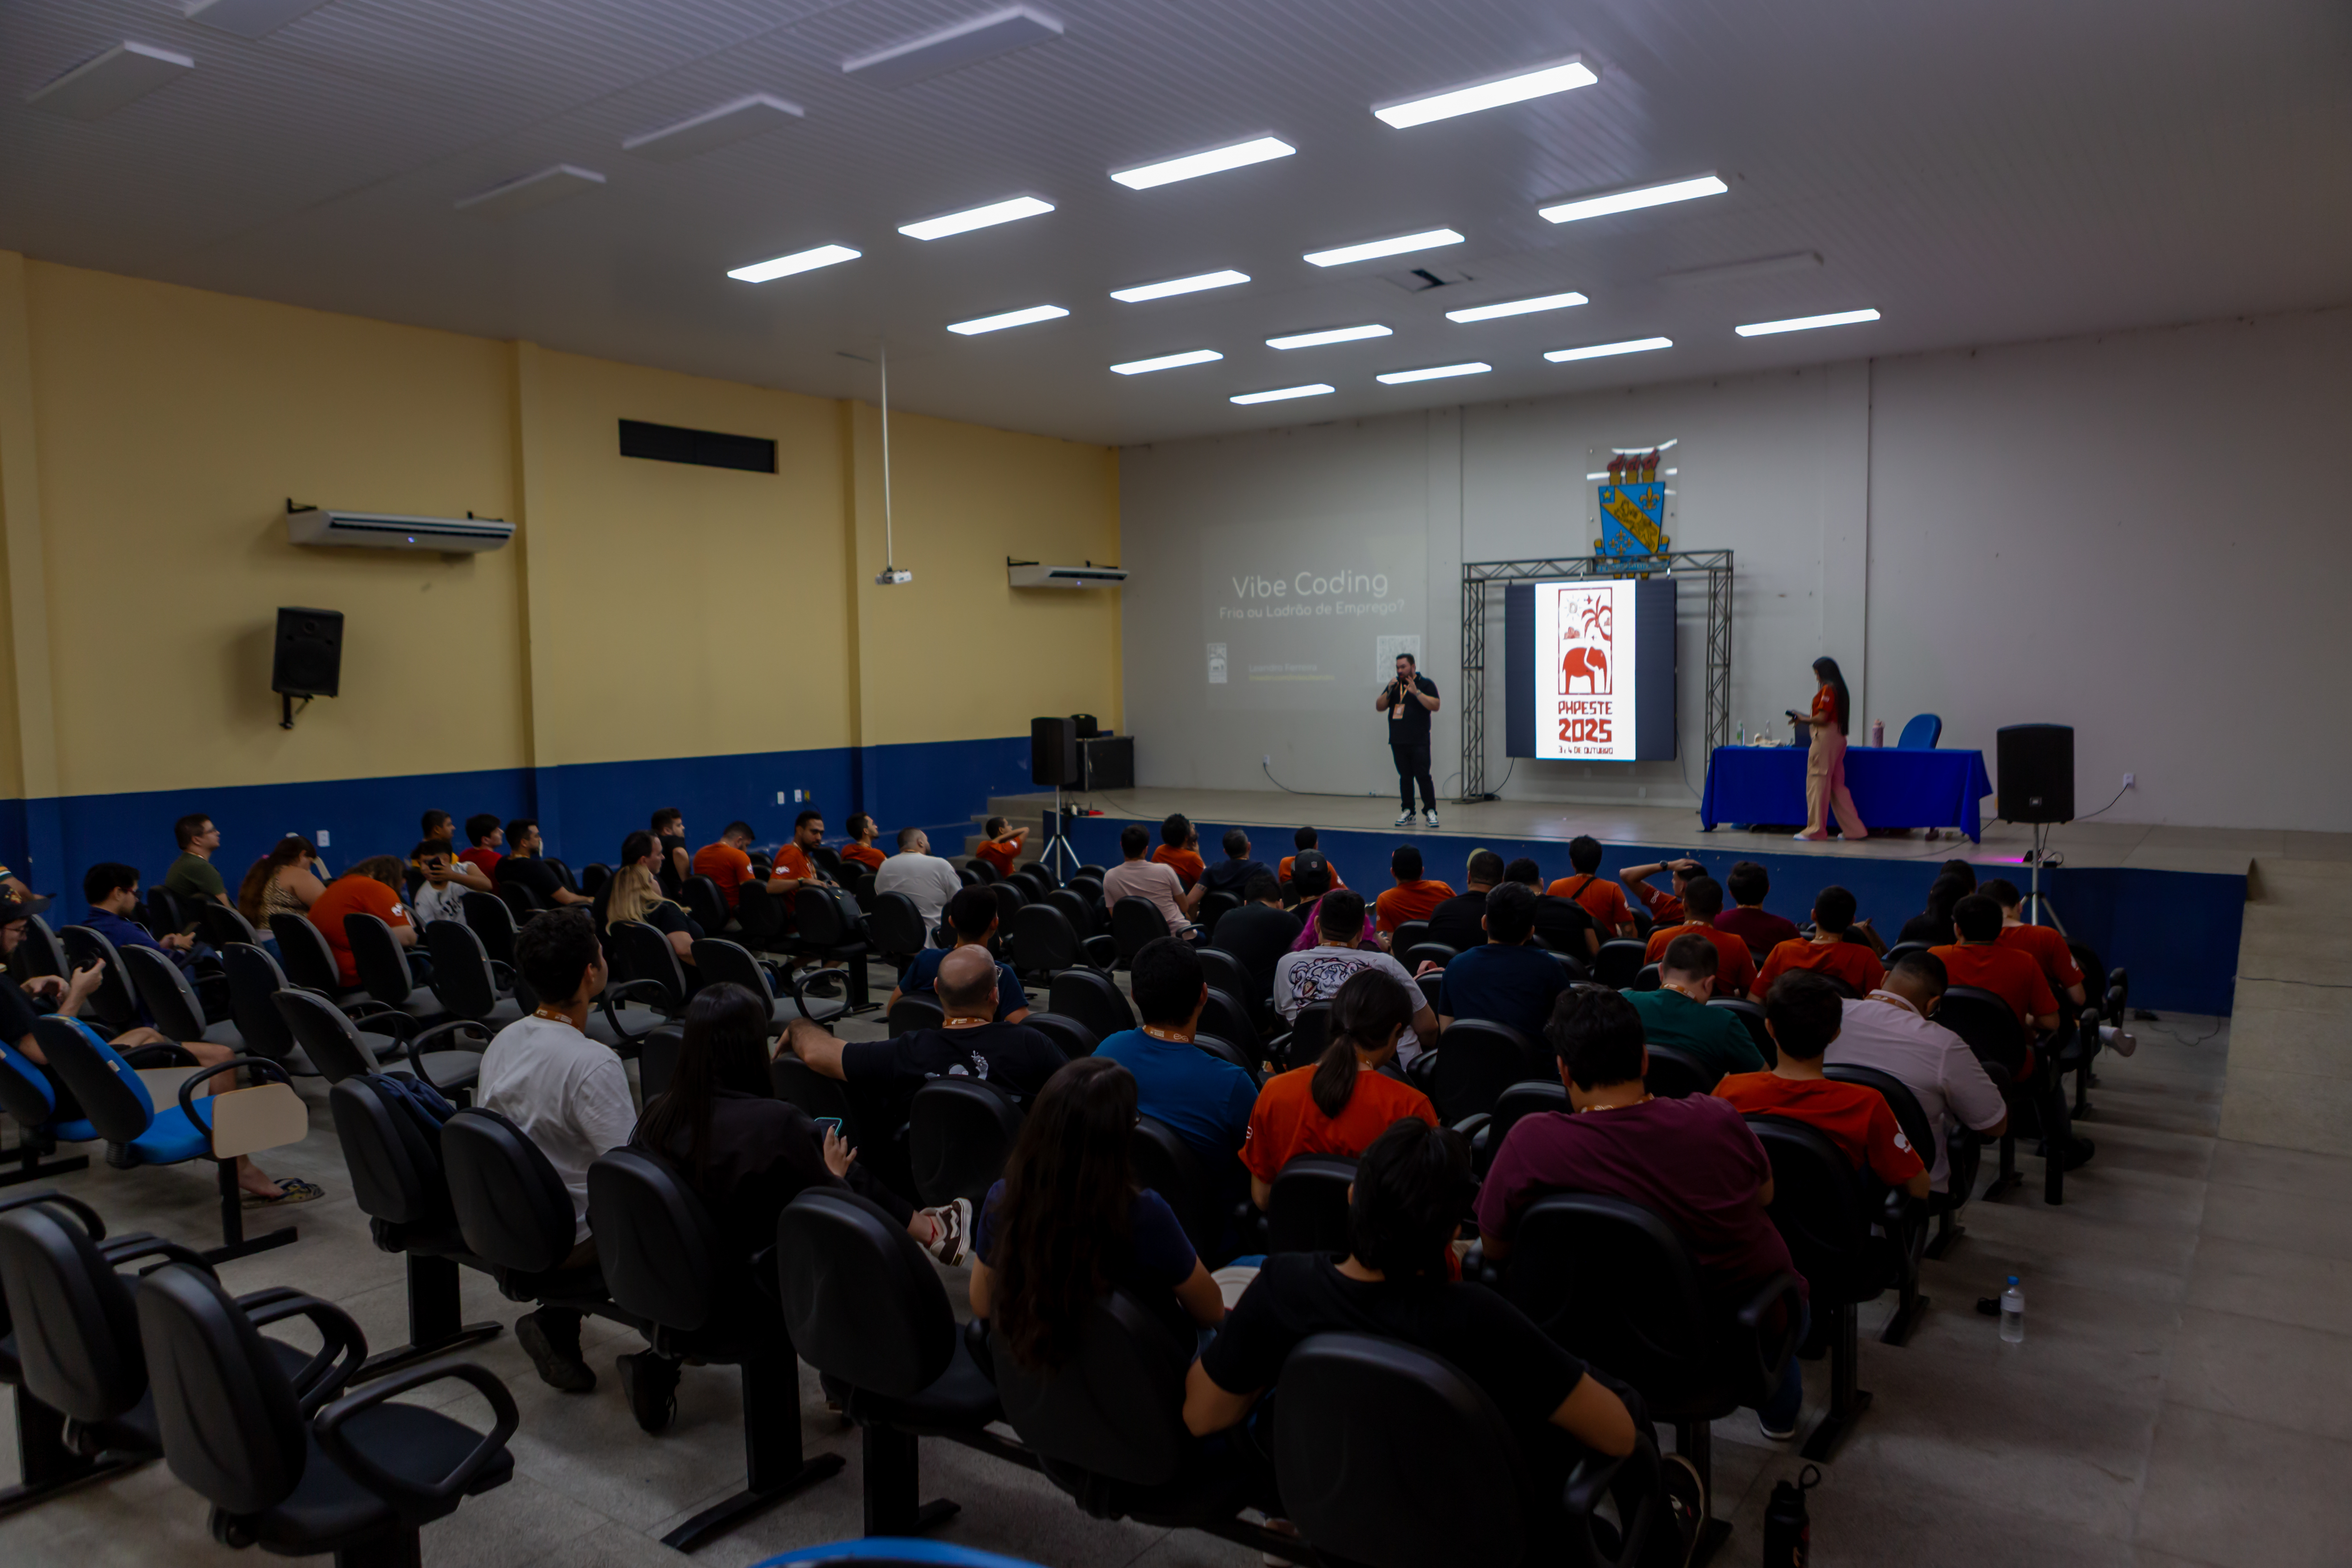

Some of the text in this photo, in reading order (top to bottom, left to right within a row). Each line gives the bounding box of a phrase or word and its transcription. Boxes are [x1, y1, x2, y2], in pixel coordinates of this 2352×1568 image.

[1232, 570, 1388, 598] Vibe Coding
[1220, 599, 1405, 619] Fria ou Ladrão de Emprego?
[1558, 700, 1613, 715] PHPESTE
[1559, 718, 1612, 743] 2025
[1174, 1033, 1189, 1042] exa
